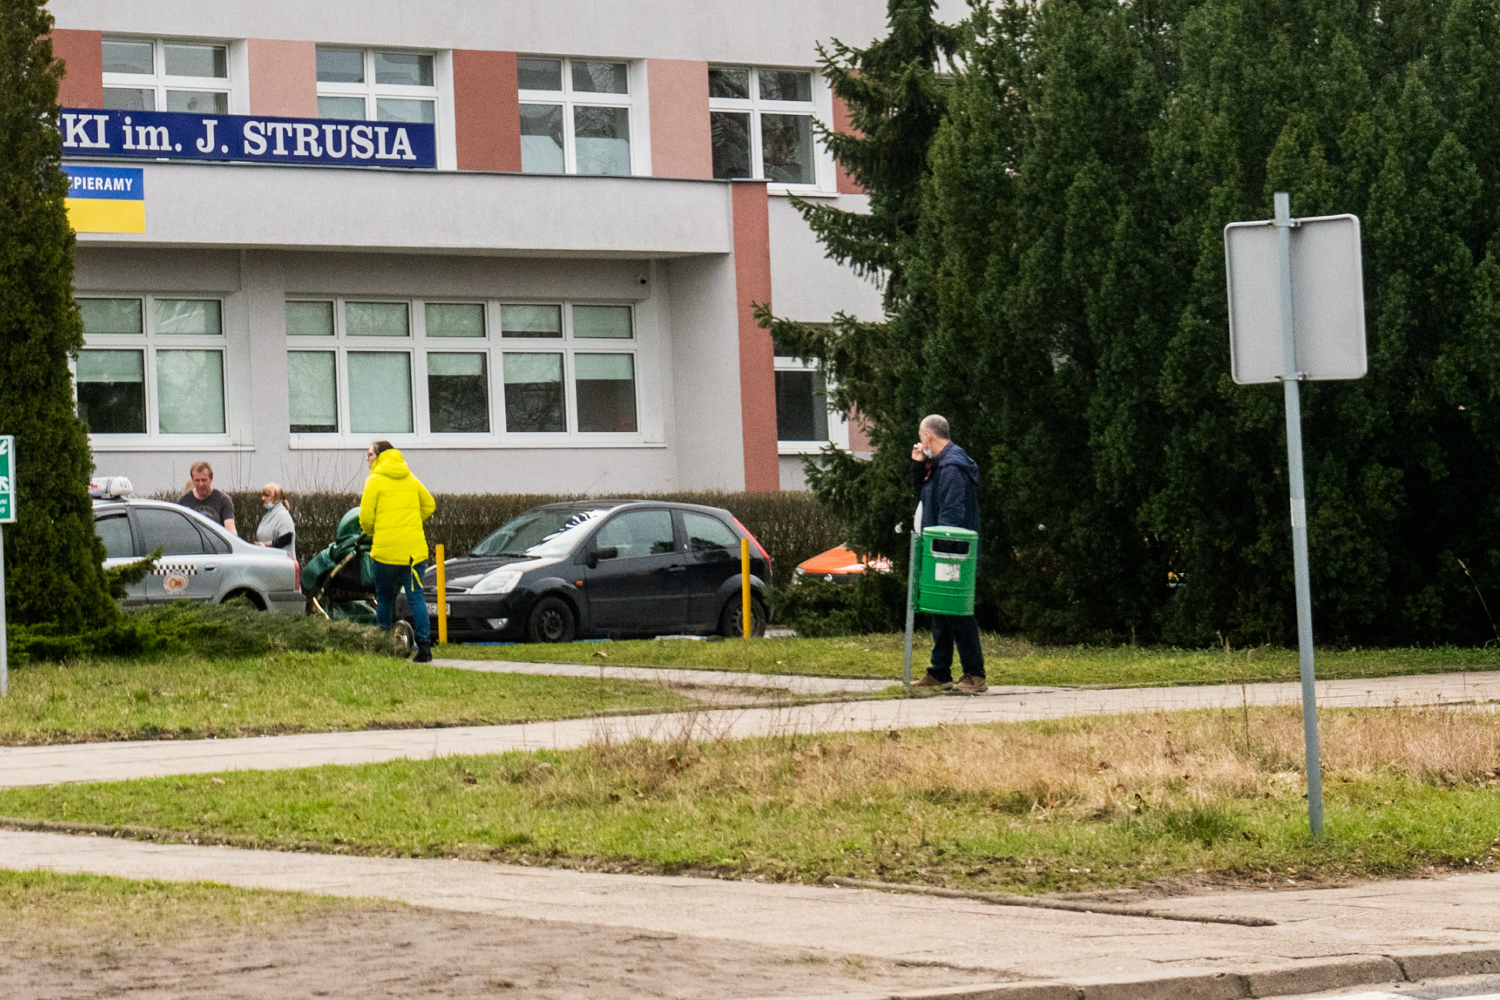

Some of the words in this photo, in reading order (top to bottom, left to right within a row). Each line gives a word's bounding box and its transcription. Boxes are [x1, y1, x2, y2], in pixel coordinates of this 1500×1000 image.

[123, 116, 182, 152] im.
[196, 119, 229, 154] J.
[243, 120, 417, 161] STRUSIA
